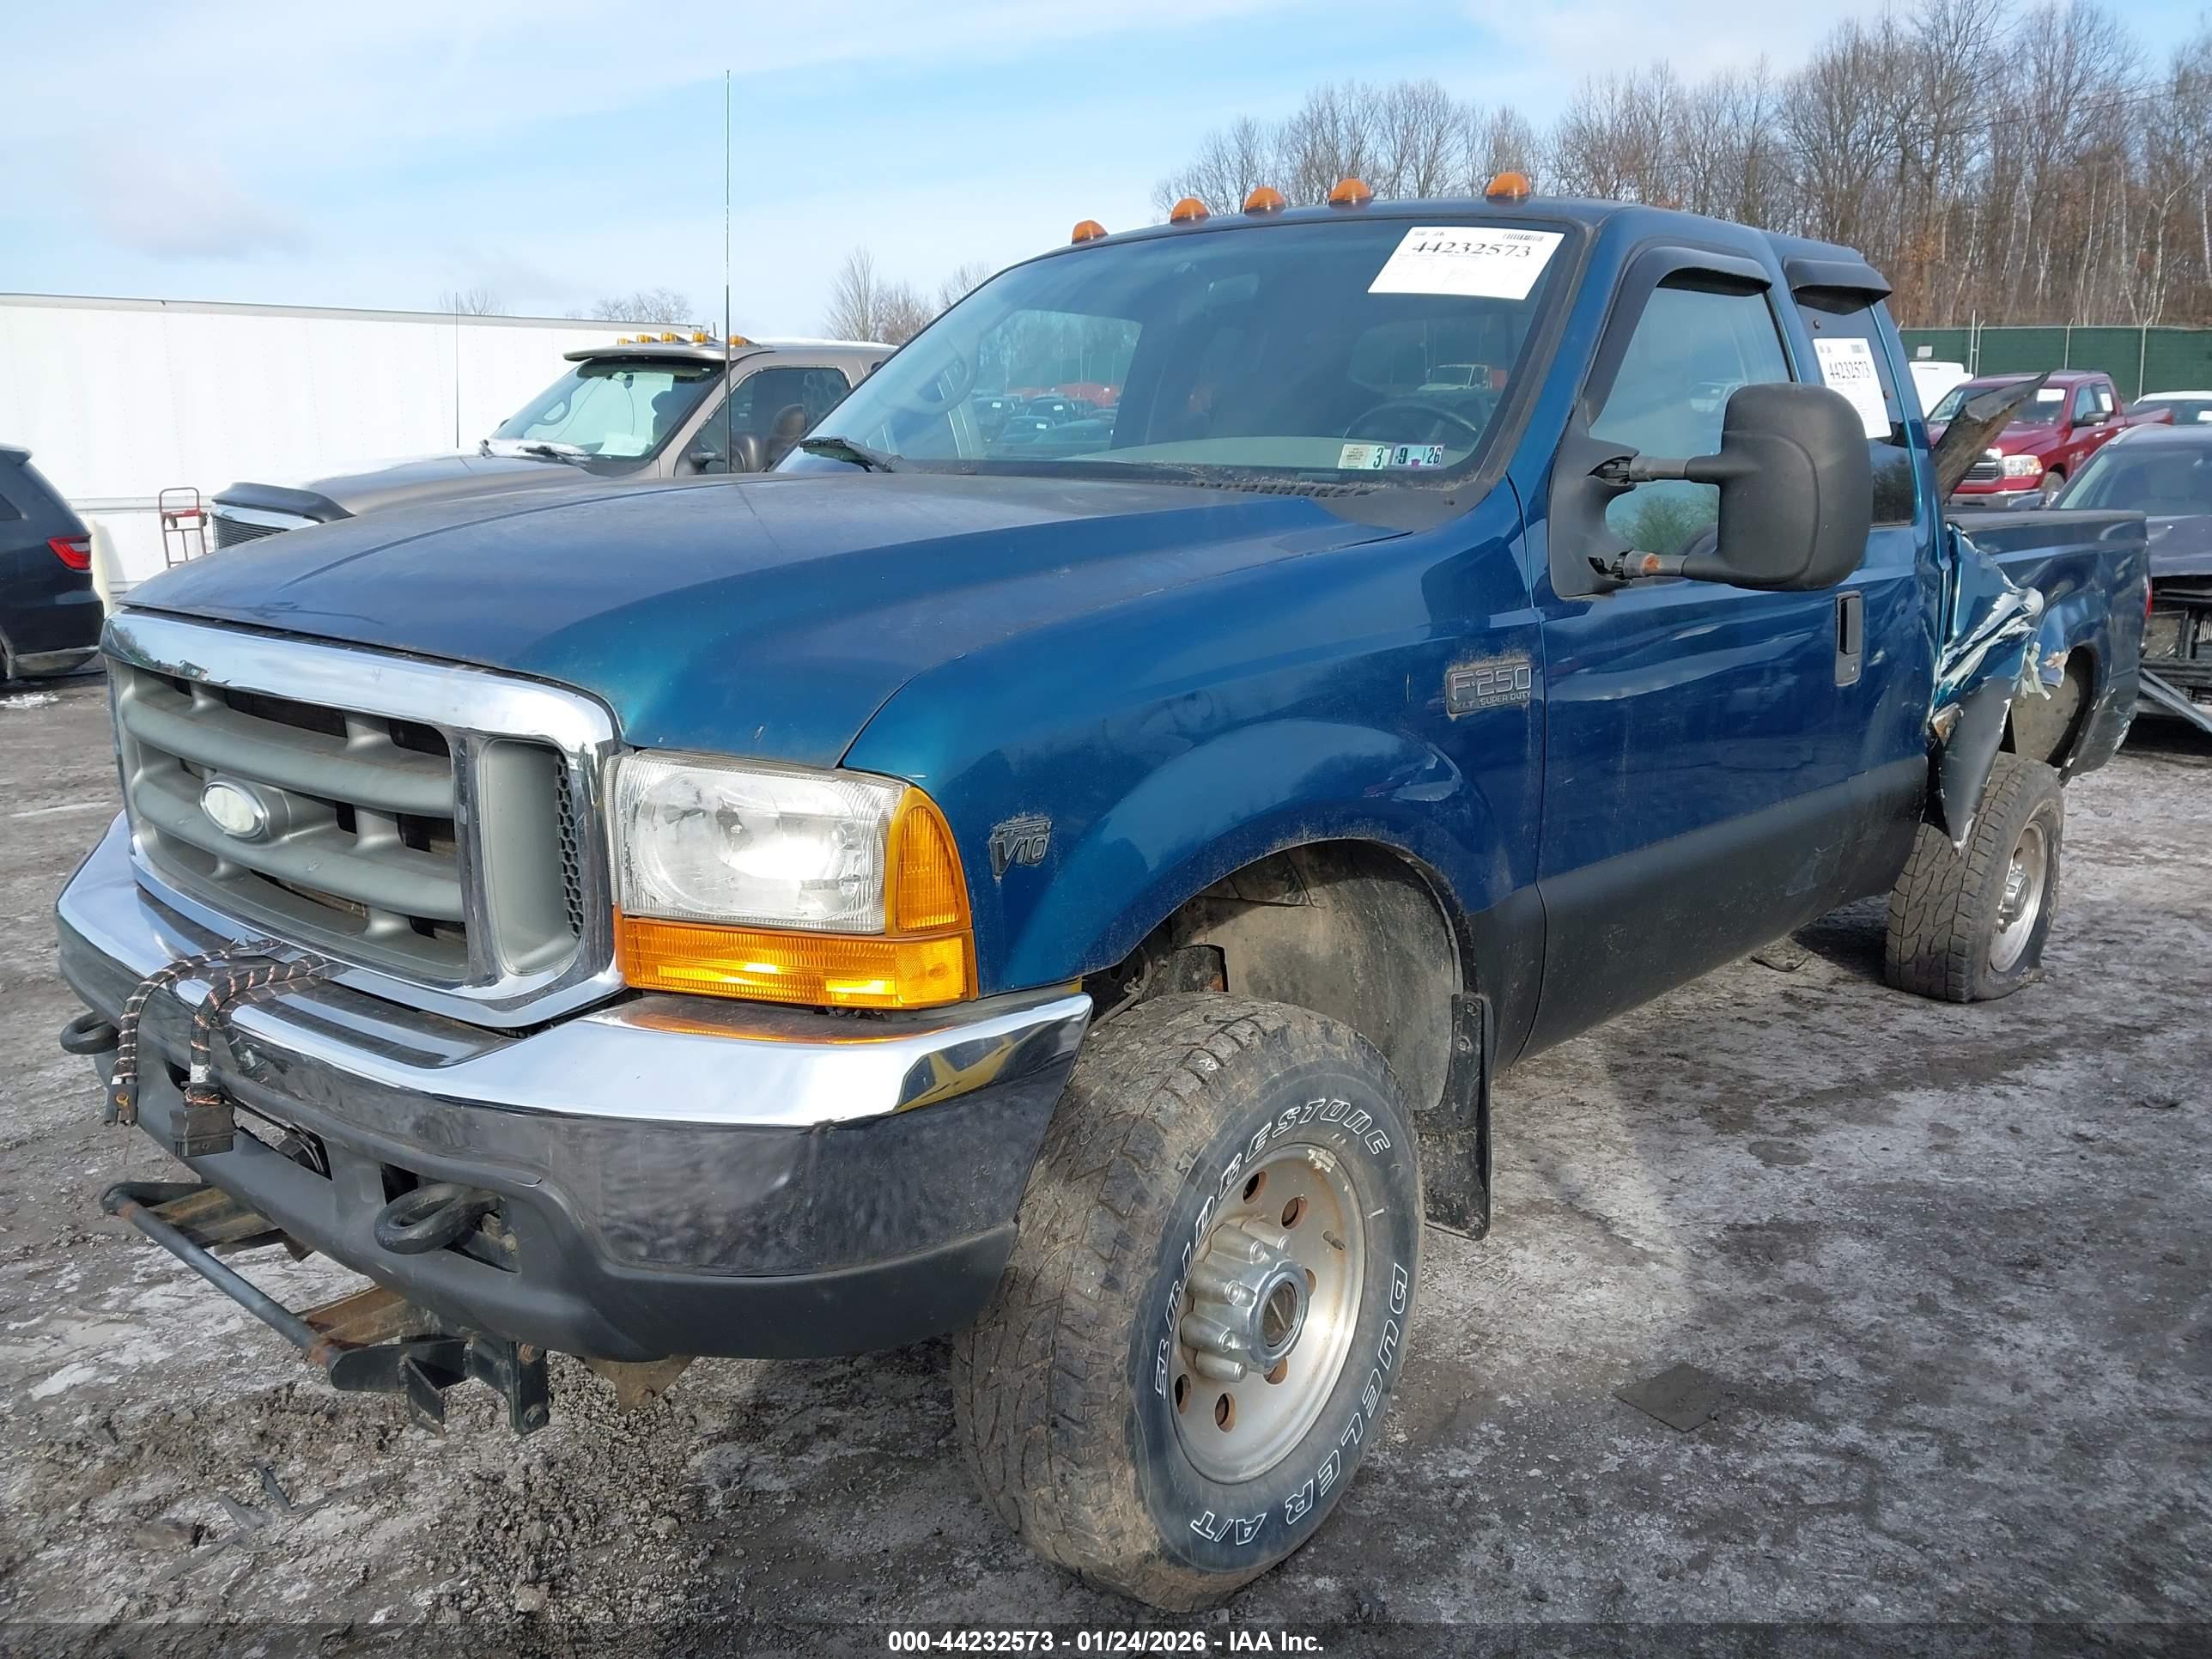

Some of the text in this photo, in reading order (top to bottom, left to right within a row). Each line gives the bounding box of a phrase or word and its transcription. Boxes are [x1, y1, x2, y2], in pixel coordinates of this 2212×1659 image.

[1411, 241, 1532, 258] 44232573
[1828, 361, 1870, 379] 44232573
[1373, 447, 1384, 469] 3
[1427, 447, 1442, 464] 26
[1480, 696, 1508, 706] SUPER
[1510, 691, 1531, 702] DUTY
[992, 835, 1048, 875] V10
[1155, 1097, 1391, 1401] BRIDGESTONE
[1190, 1263, 1408, 1546] DUELER A/T
